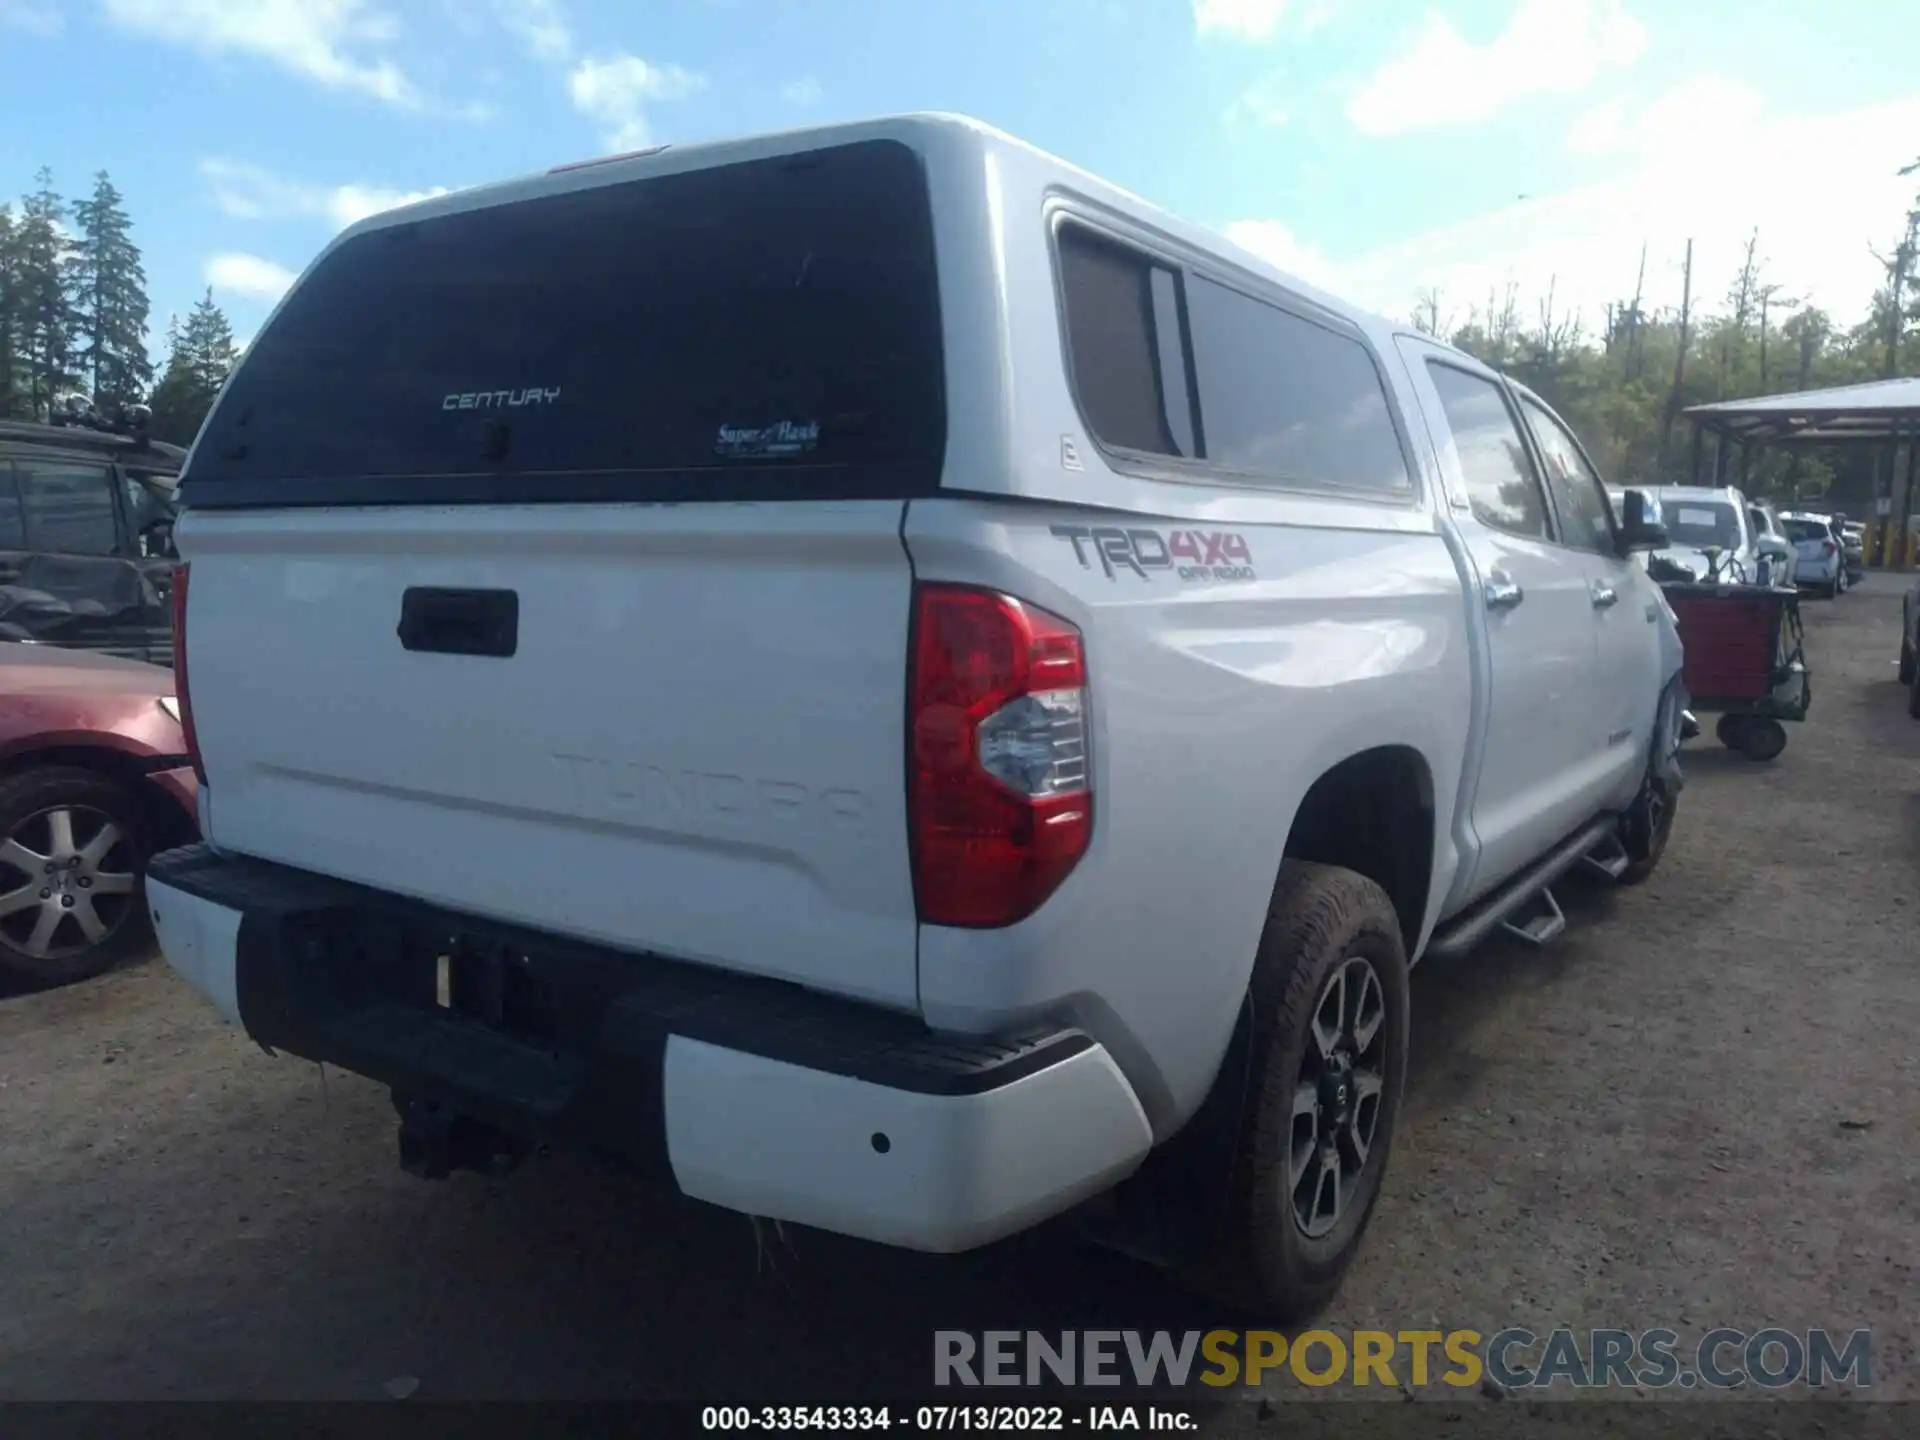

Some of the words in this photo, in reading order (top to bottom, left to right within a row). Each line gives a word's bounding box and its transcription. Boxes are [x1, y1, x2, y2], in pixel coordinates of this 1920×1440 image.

[441, 387, 561, 410] CENTURY
[718, 423, 760, 451] Super
[1049, 523, 1174, 582] TRD
[1177, 565, 1211, 580] OFF
[1213, 565, 1257, 582] ROAD
[548, 751, 871, 833] TUNDRA
